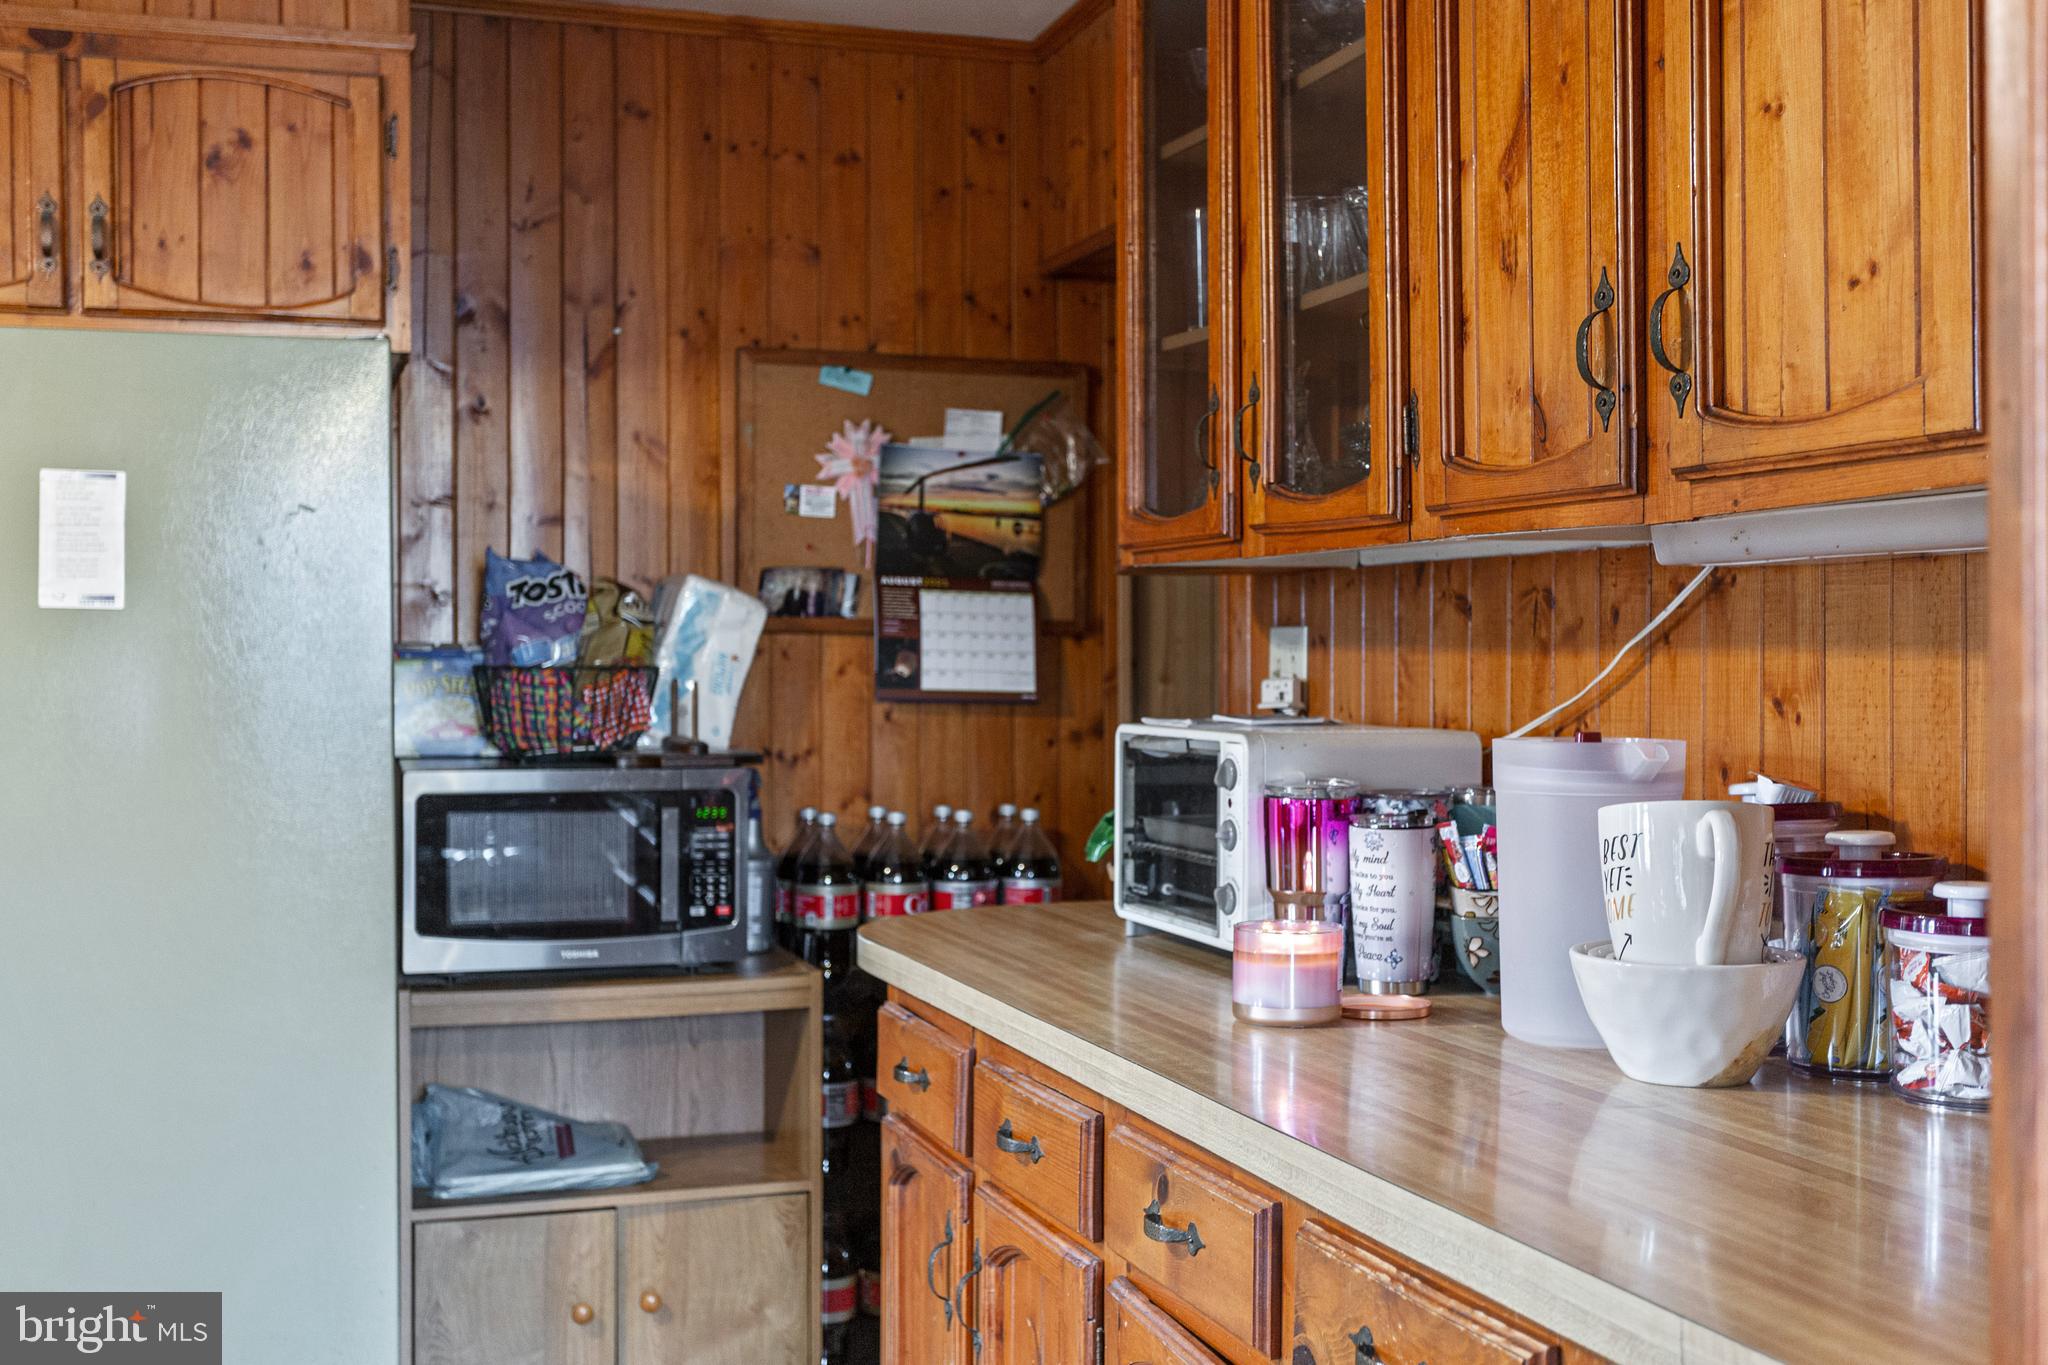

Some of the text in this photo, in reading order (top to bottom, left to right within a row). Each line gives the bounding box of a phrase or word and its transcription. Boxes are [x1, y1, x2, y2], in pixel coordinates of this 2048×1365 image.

[544, 601, 586, 622] SCOO
[1363, 850, 1389, 865] mind
[1603, 832, 1643, 865] BEST
[1763, 841, 1775, 867] TH
[1604, 866, 1624, 894] YET
[1365, 884, 1397, 898] Heart
[1607, 893, 1637, 923] OME
[1371, 917, 1396, 931] Soul
[1358, 943, 1383, 961] Peace
